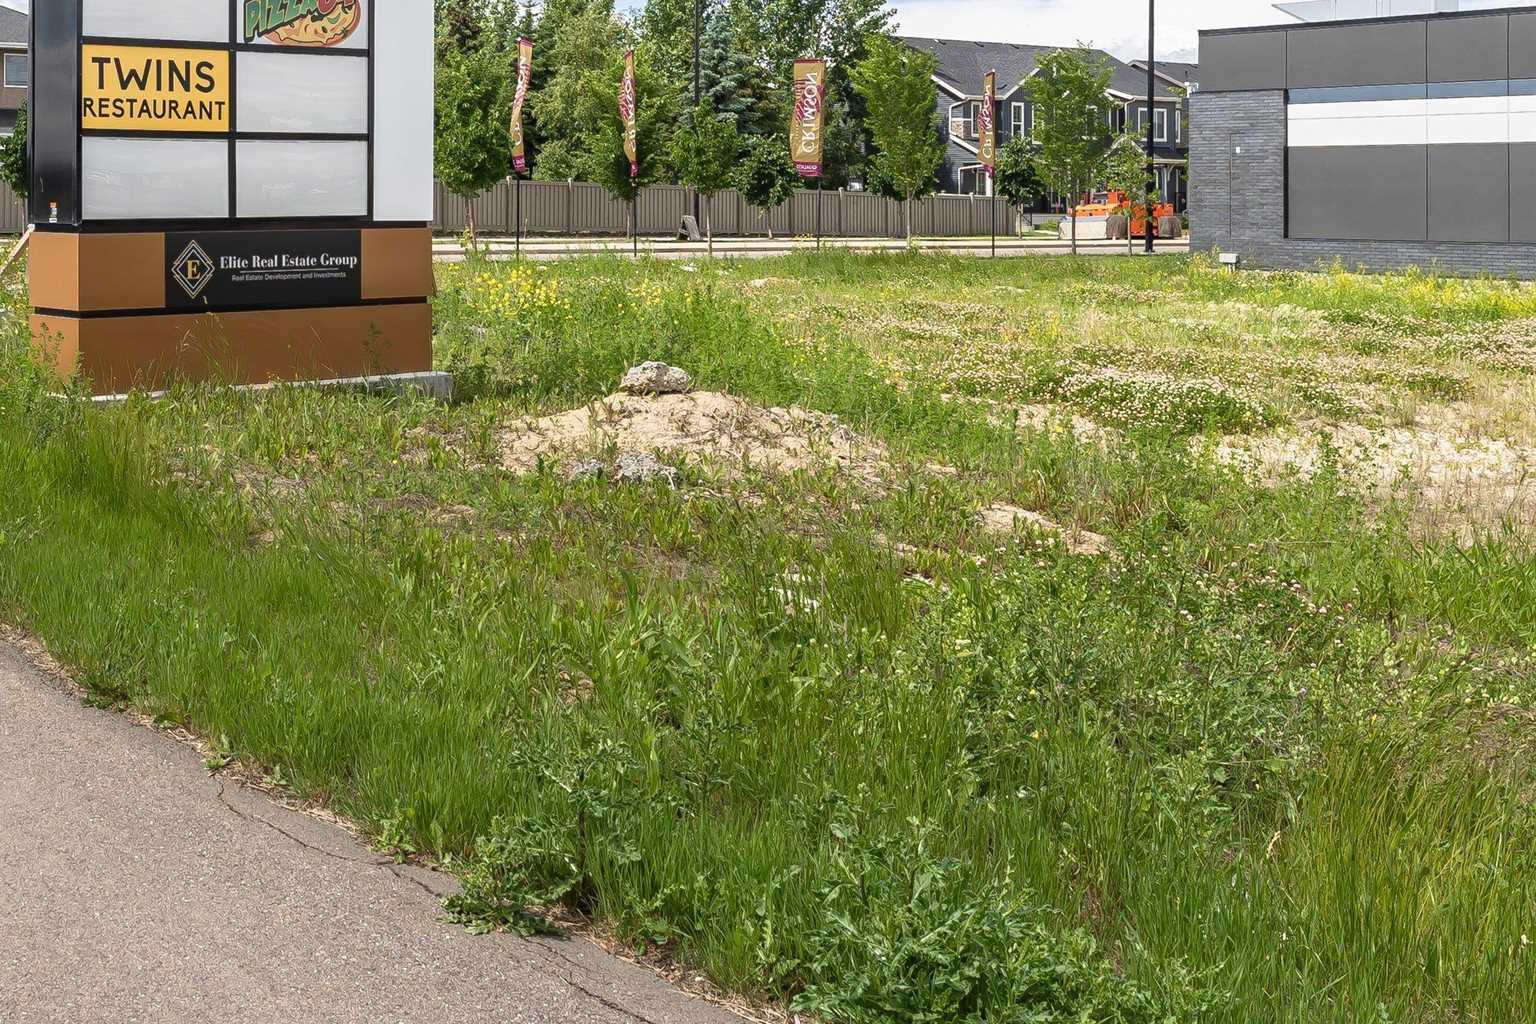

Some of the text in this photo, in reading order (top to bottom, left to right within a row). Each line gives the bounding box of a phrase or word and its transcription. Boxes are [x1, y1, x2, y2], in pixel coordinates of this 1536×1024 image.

[92, 57, 215, 93] TWINS
[83, 97, 225, 121] RESTAURANT
[220, 253, 357, 269] Elite Real Estate Group
[265, 272, 301, 282] Development
